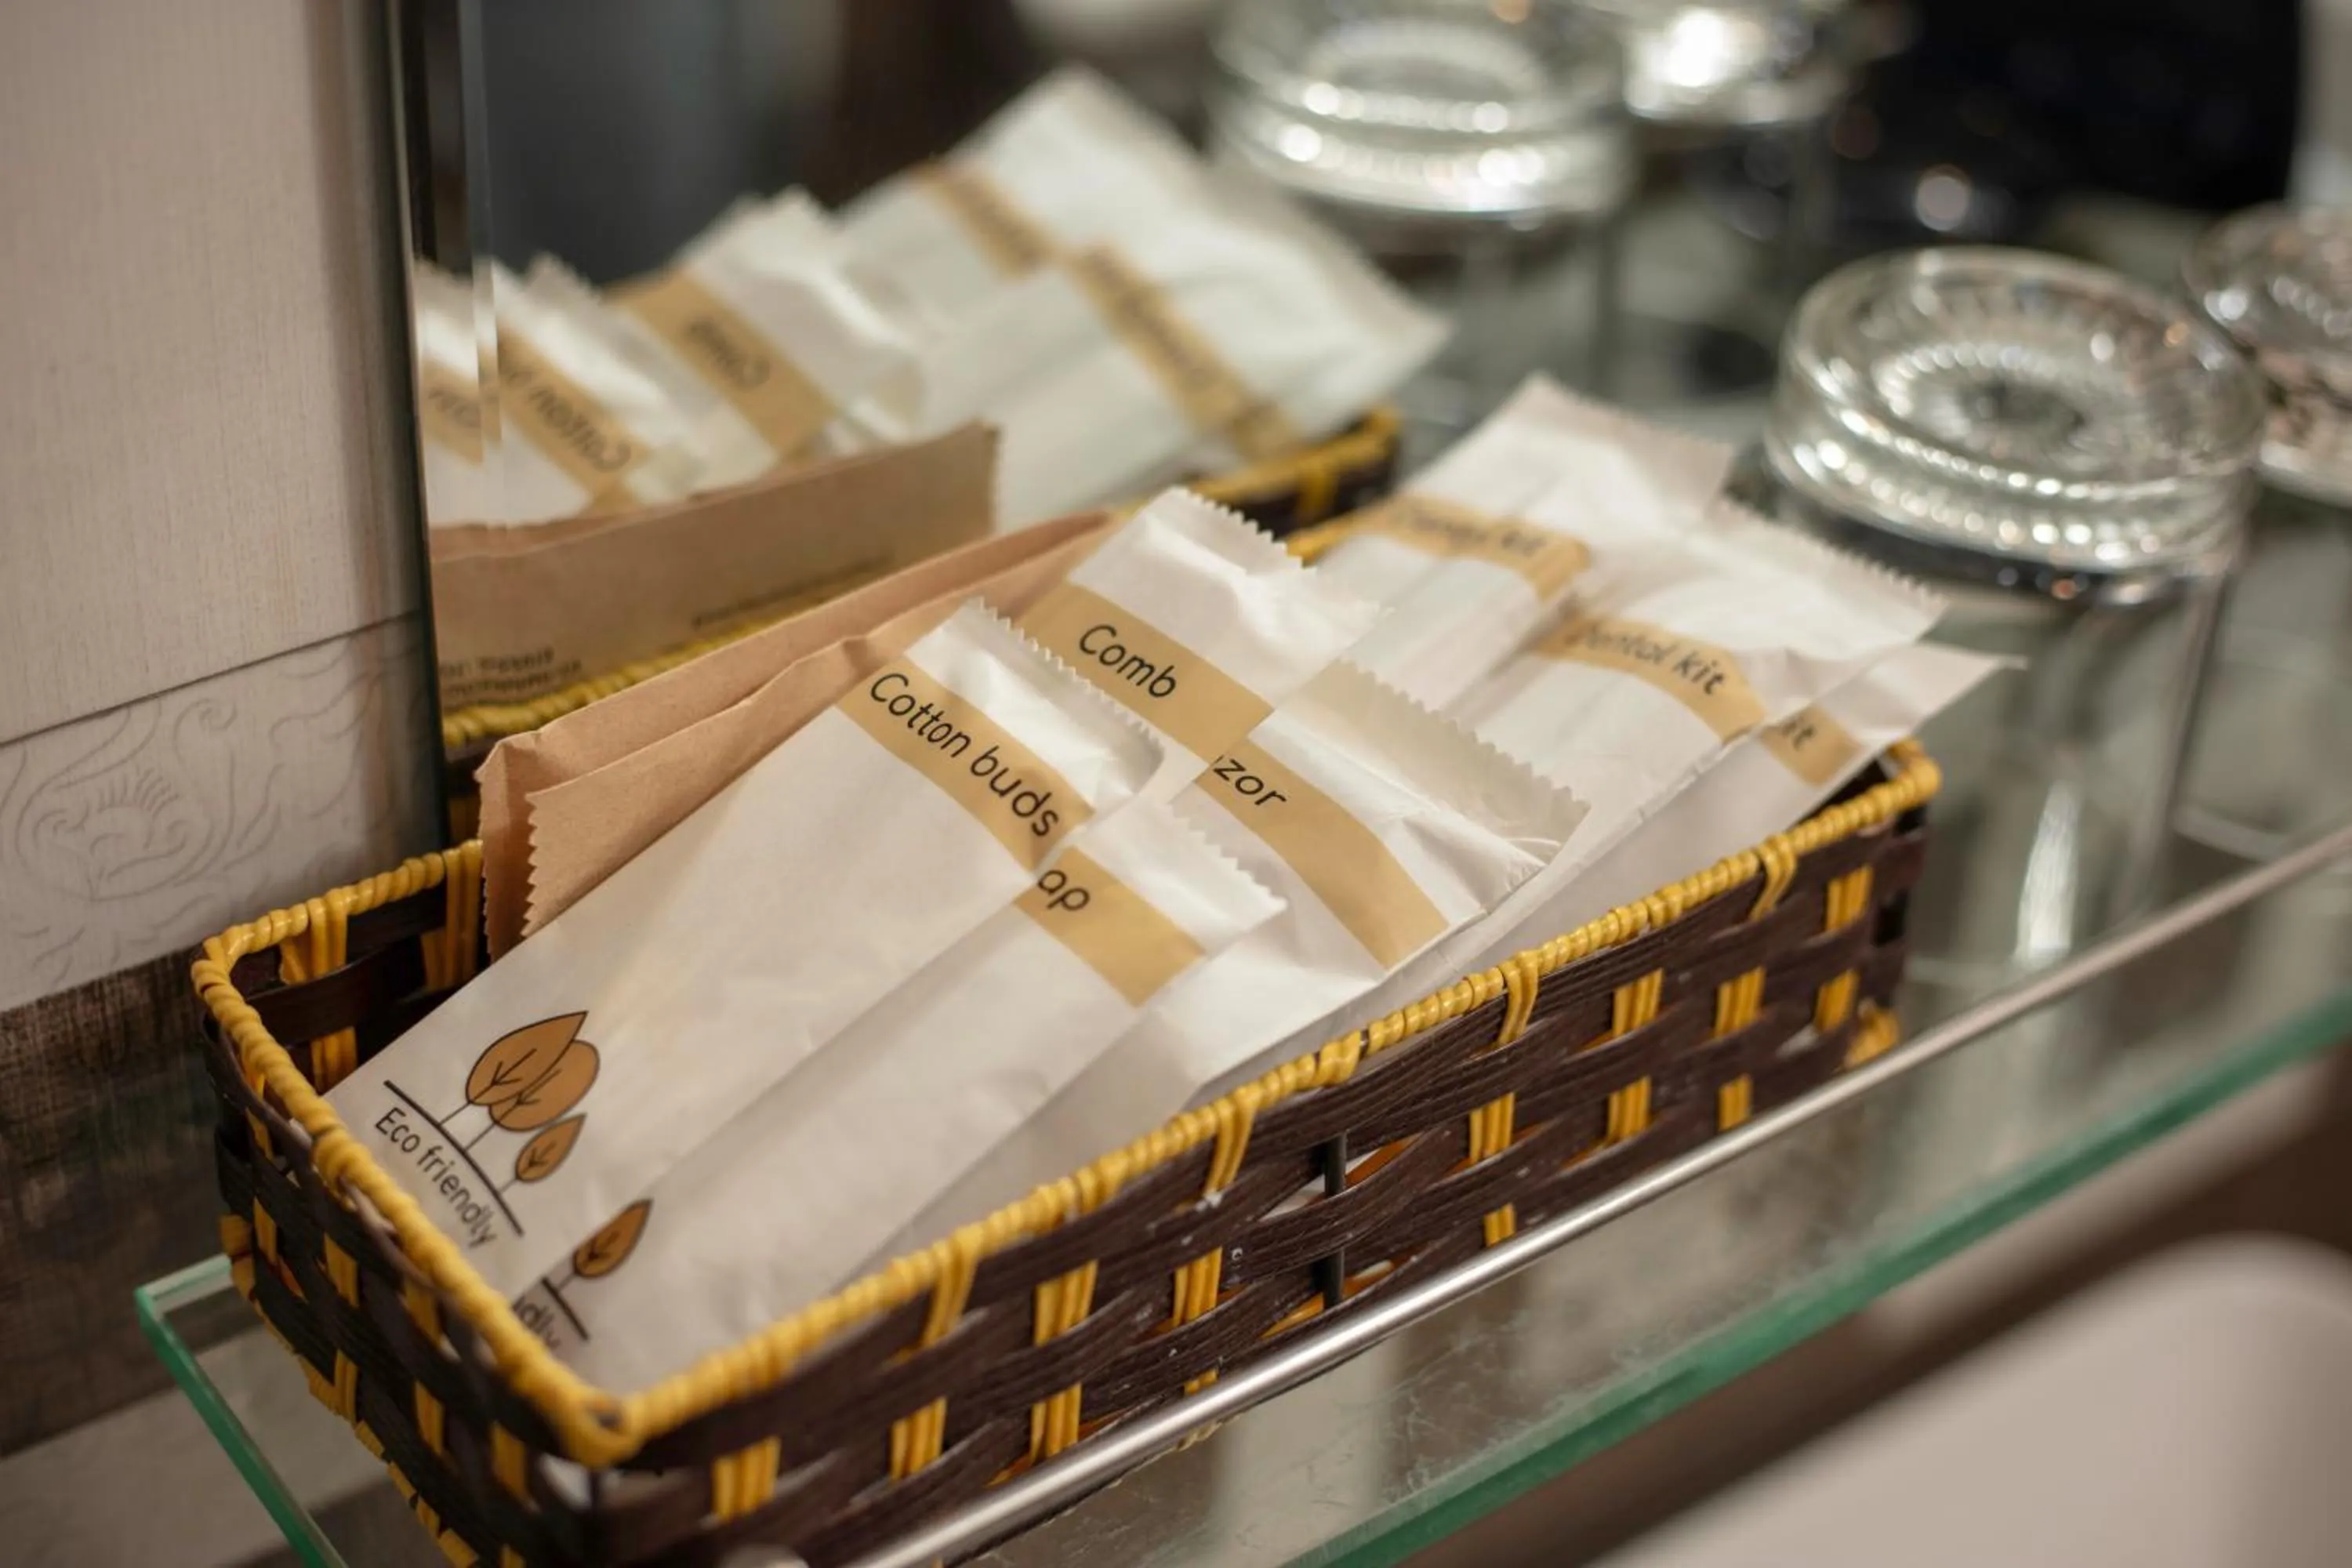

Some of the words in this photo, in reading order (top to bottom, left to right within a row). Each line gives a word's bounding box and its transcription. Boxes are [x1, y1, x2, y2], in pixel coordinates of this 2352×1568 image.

[1078, 624, 1177, 699] Comb
[1671, 650, 1725, 695] kit
[869, 673, 972, 759] Cotton
[969, 746, 1060, 837] buds
[1212, 753, 1287, 807] zor
[375, 1106, 421, 1153] Eco
[415, 1145, 498, 1249] friendly
